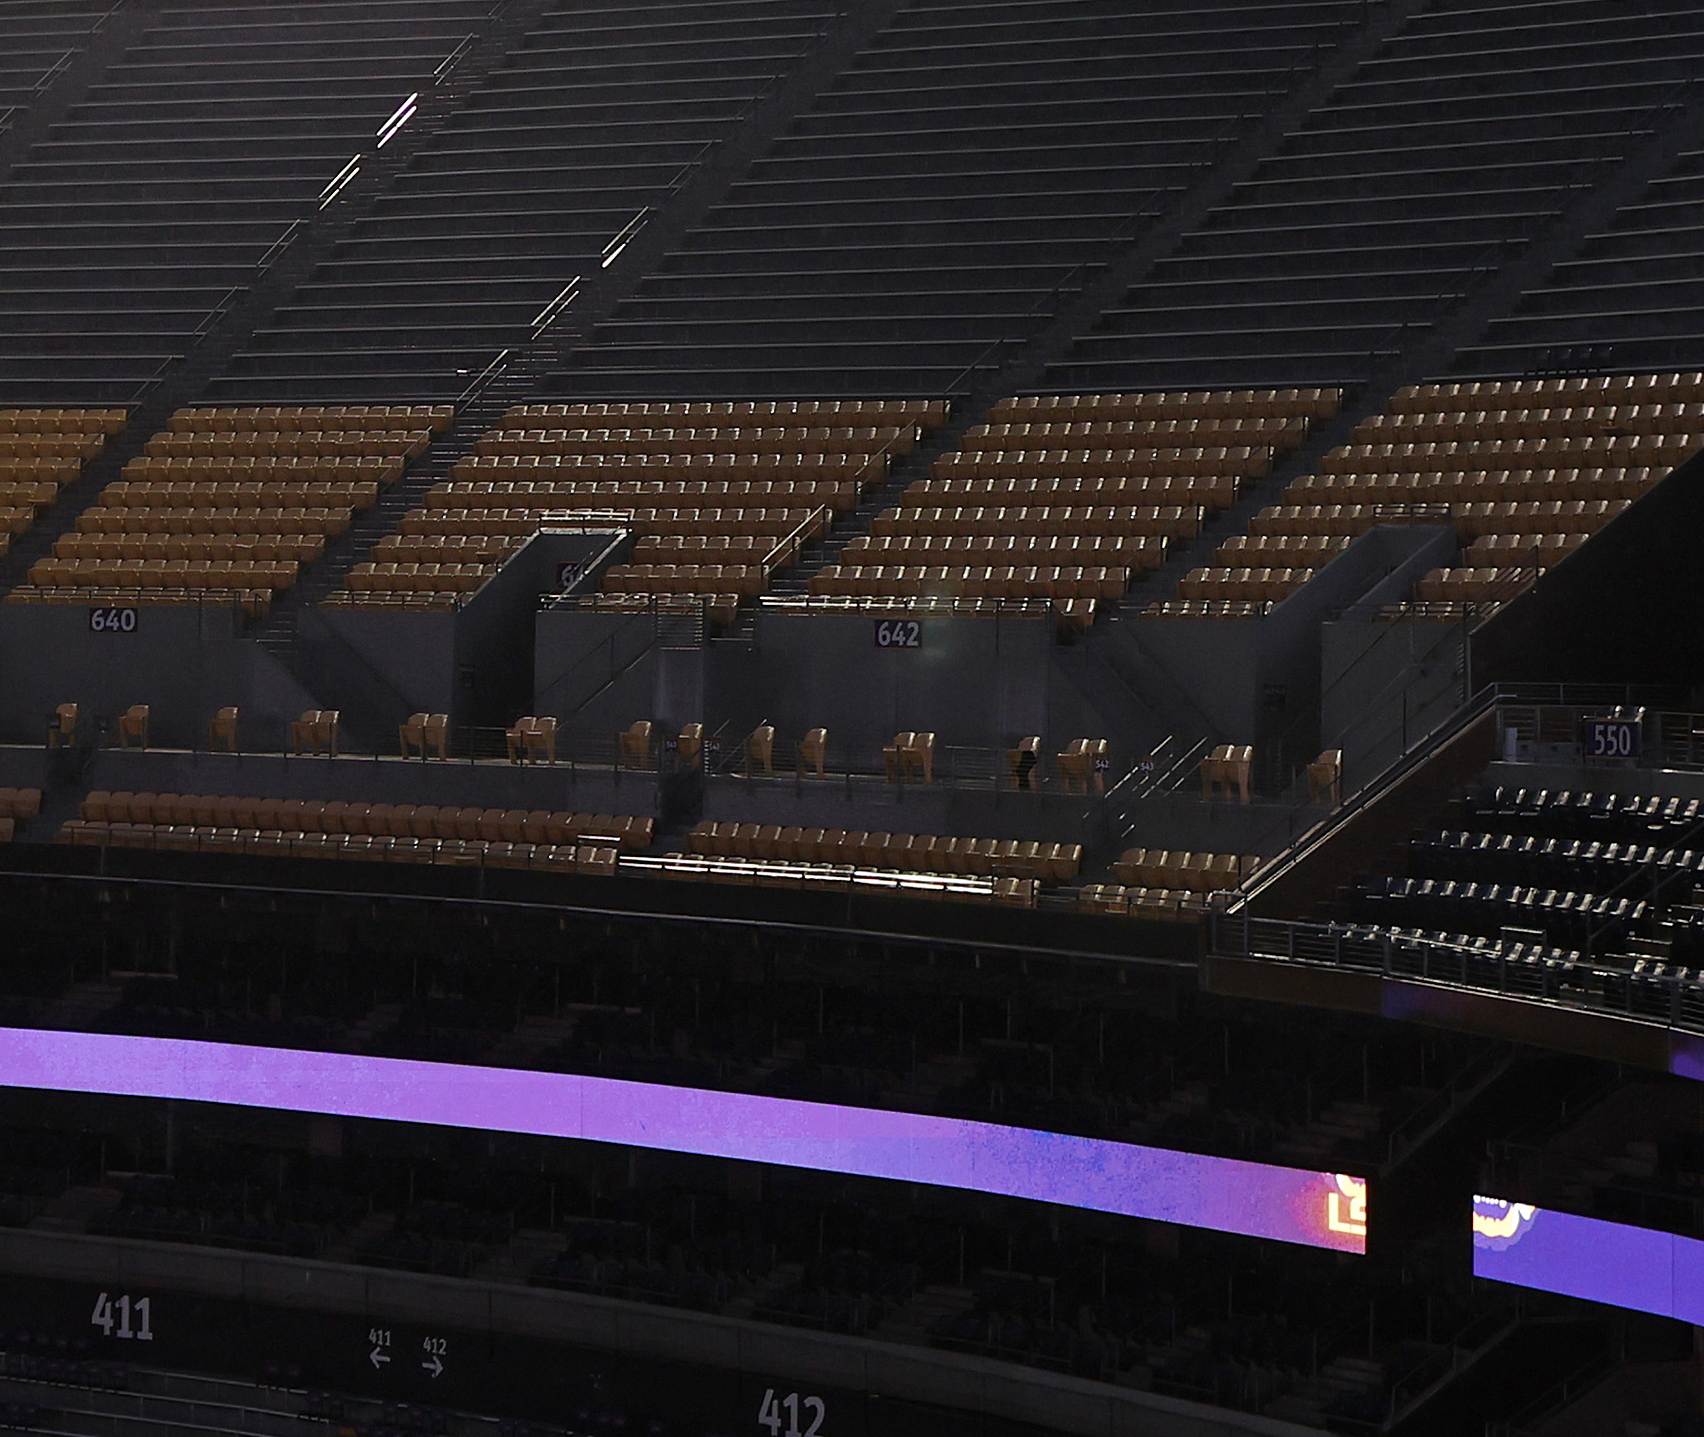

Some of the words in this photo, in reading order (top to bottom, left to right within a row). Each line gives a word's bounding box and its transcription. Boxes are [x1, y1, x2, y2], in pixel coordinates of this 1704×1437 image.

[91, 608, 136, 632] 640
[877, 620, 920, 647] 642
[1594, 724, 1632, 756] 550
[91, 1292, 154, 1341] 411
[368, 1328, 392, 1347] 411
[423, 1337, 447, 1356] 412
[758, 1388, 826, 1437] 412
